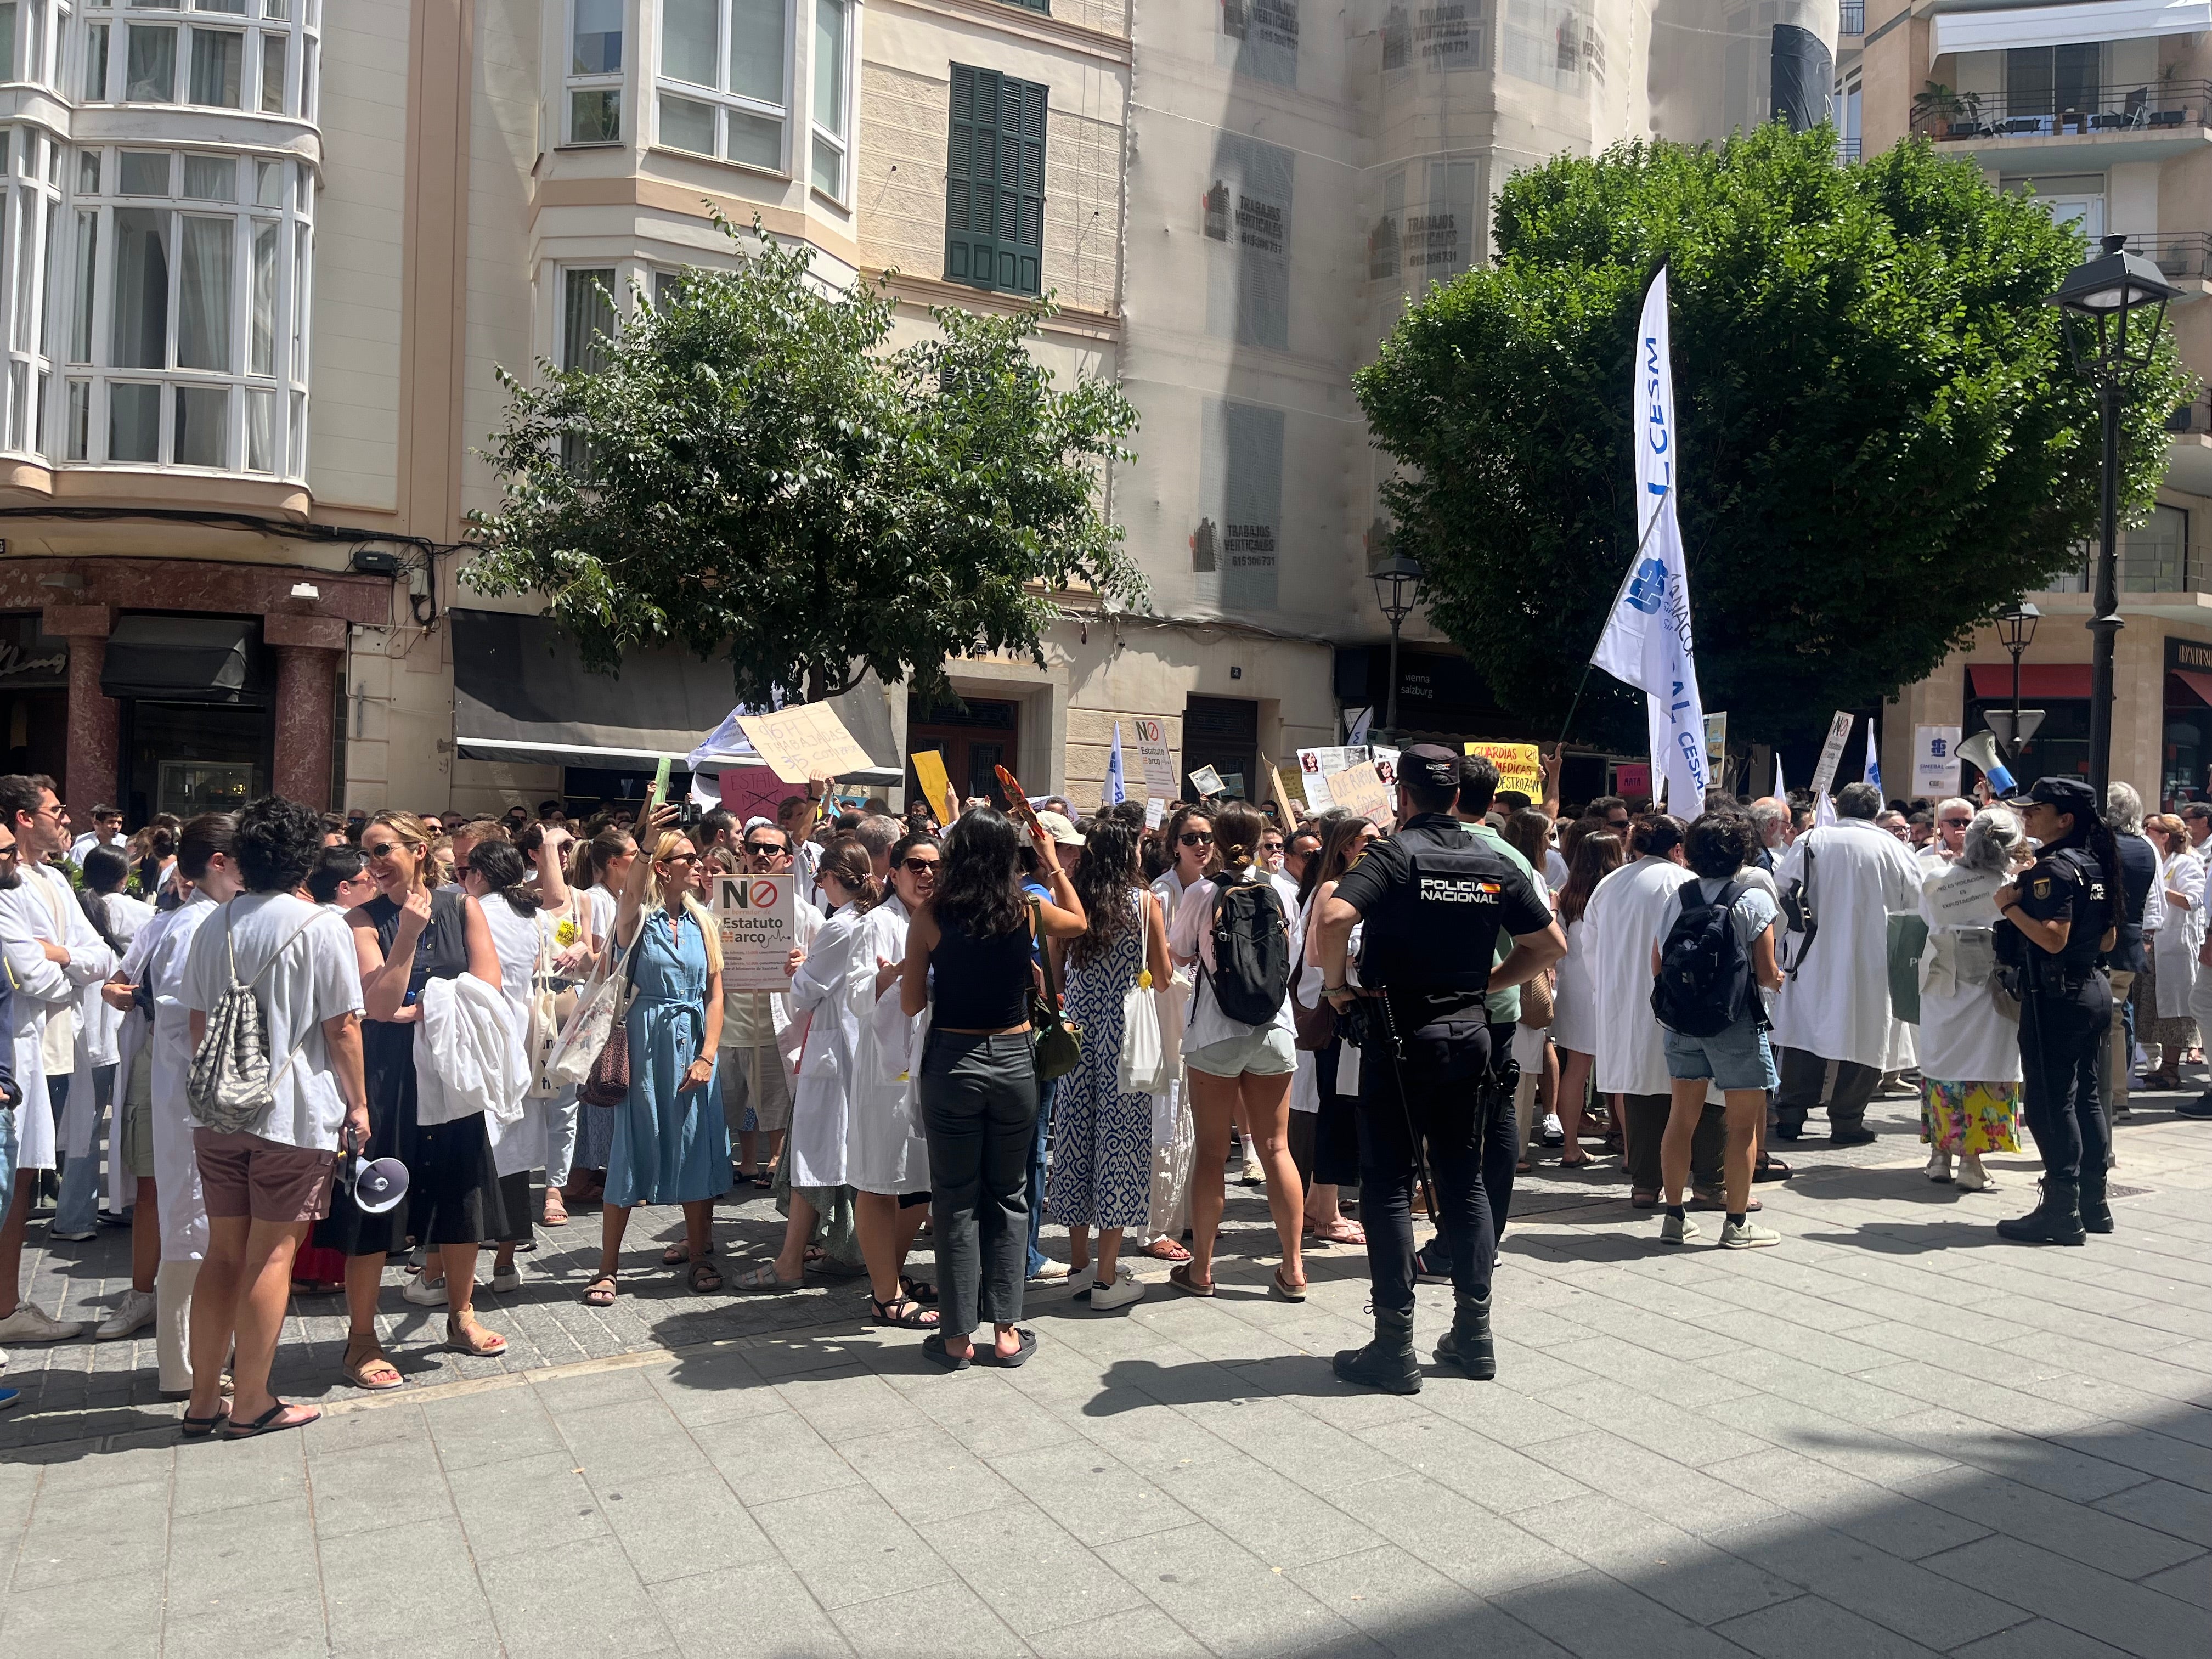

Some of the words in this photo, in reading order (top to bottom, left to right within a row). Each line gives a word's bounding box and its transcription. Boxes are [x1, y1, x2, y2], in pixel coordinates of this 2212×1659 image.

[1227, 525, 1270, 538] TRABAJOS
[1405, 674, 1430, 684] vienna
[1401, 685, 1433, 699] salzburg
[763, 727, 849, 753] TRABAJADAS
[781, 754, 809, 769] 35
[1678, 732, 1704, 791] CESM
[1497, 776, 1539, 793] DESTROZAN
[1421, 879, 1485, 893] POLICIA
[1421, 890, 1499, 905] NACIONAL
[723, 917, 783, 928] Estatuto
